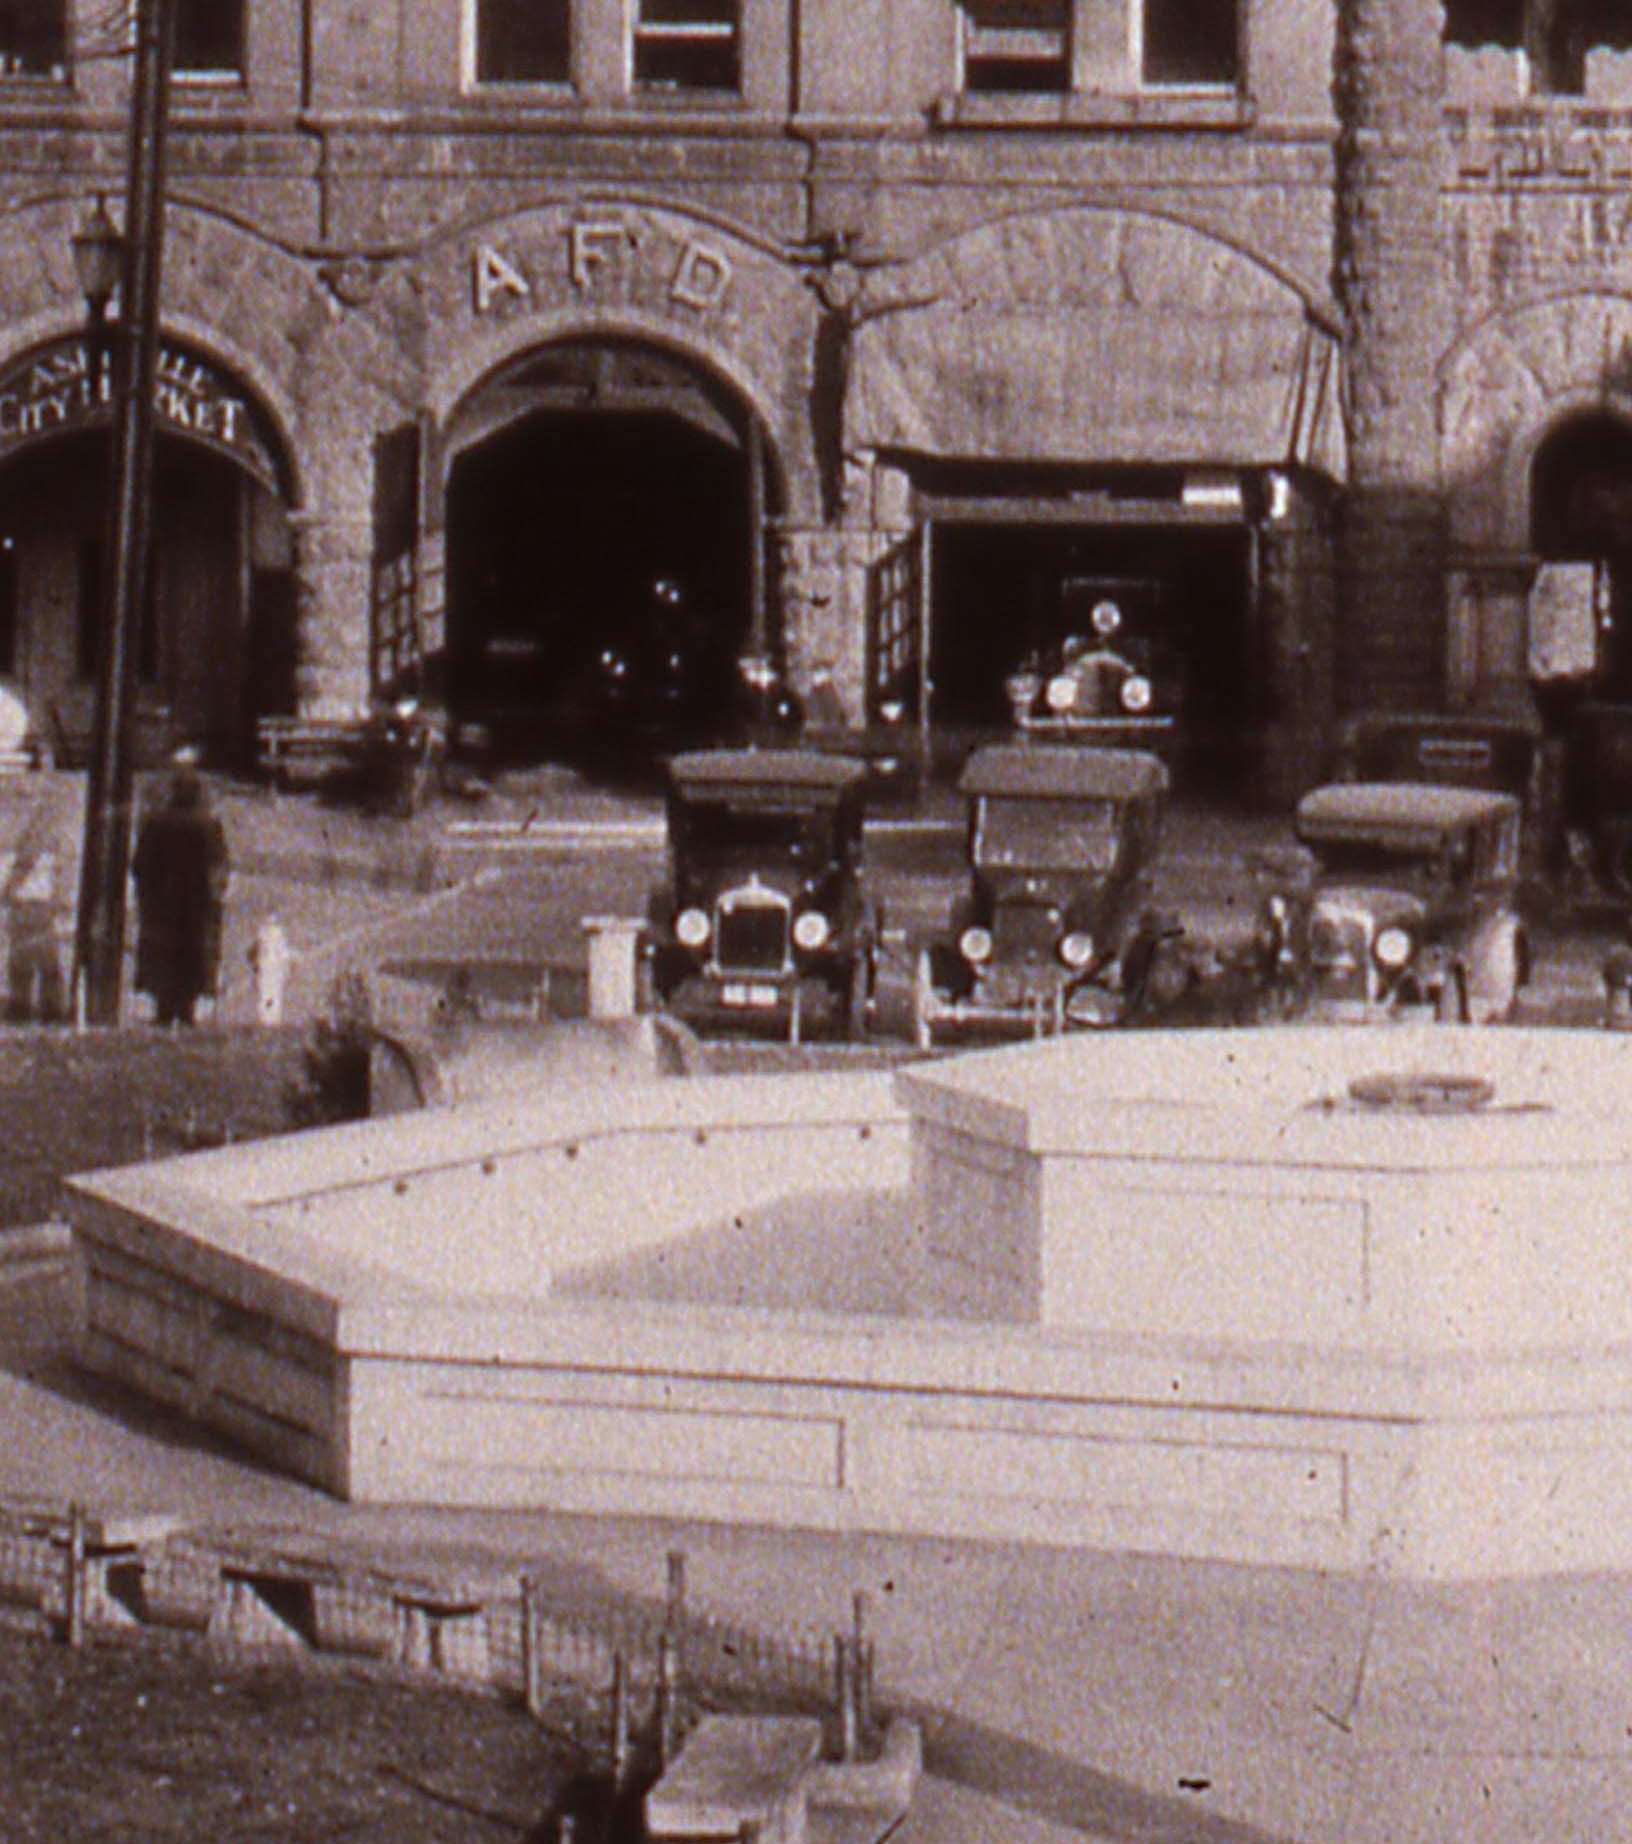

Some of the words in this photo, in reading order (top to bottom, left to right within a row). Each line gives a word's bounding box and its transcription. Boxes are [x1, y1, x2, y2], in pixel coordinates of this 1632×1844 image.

[471, 243, 530, 312] A
[568, 222, 626, 290] F
[670, 241, 733, 308] D
